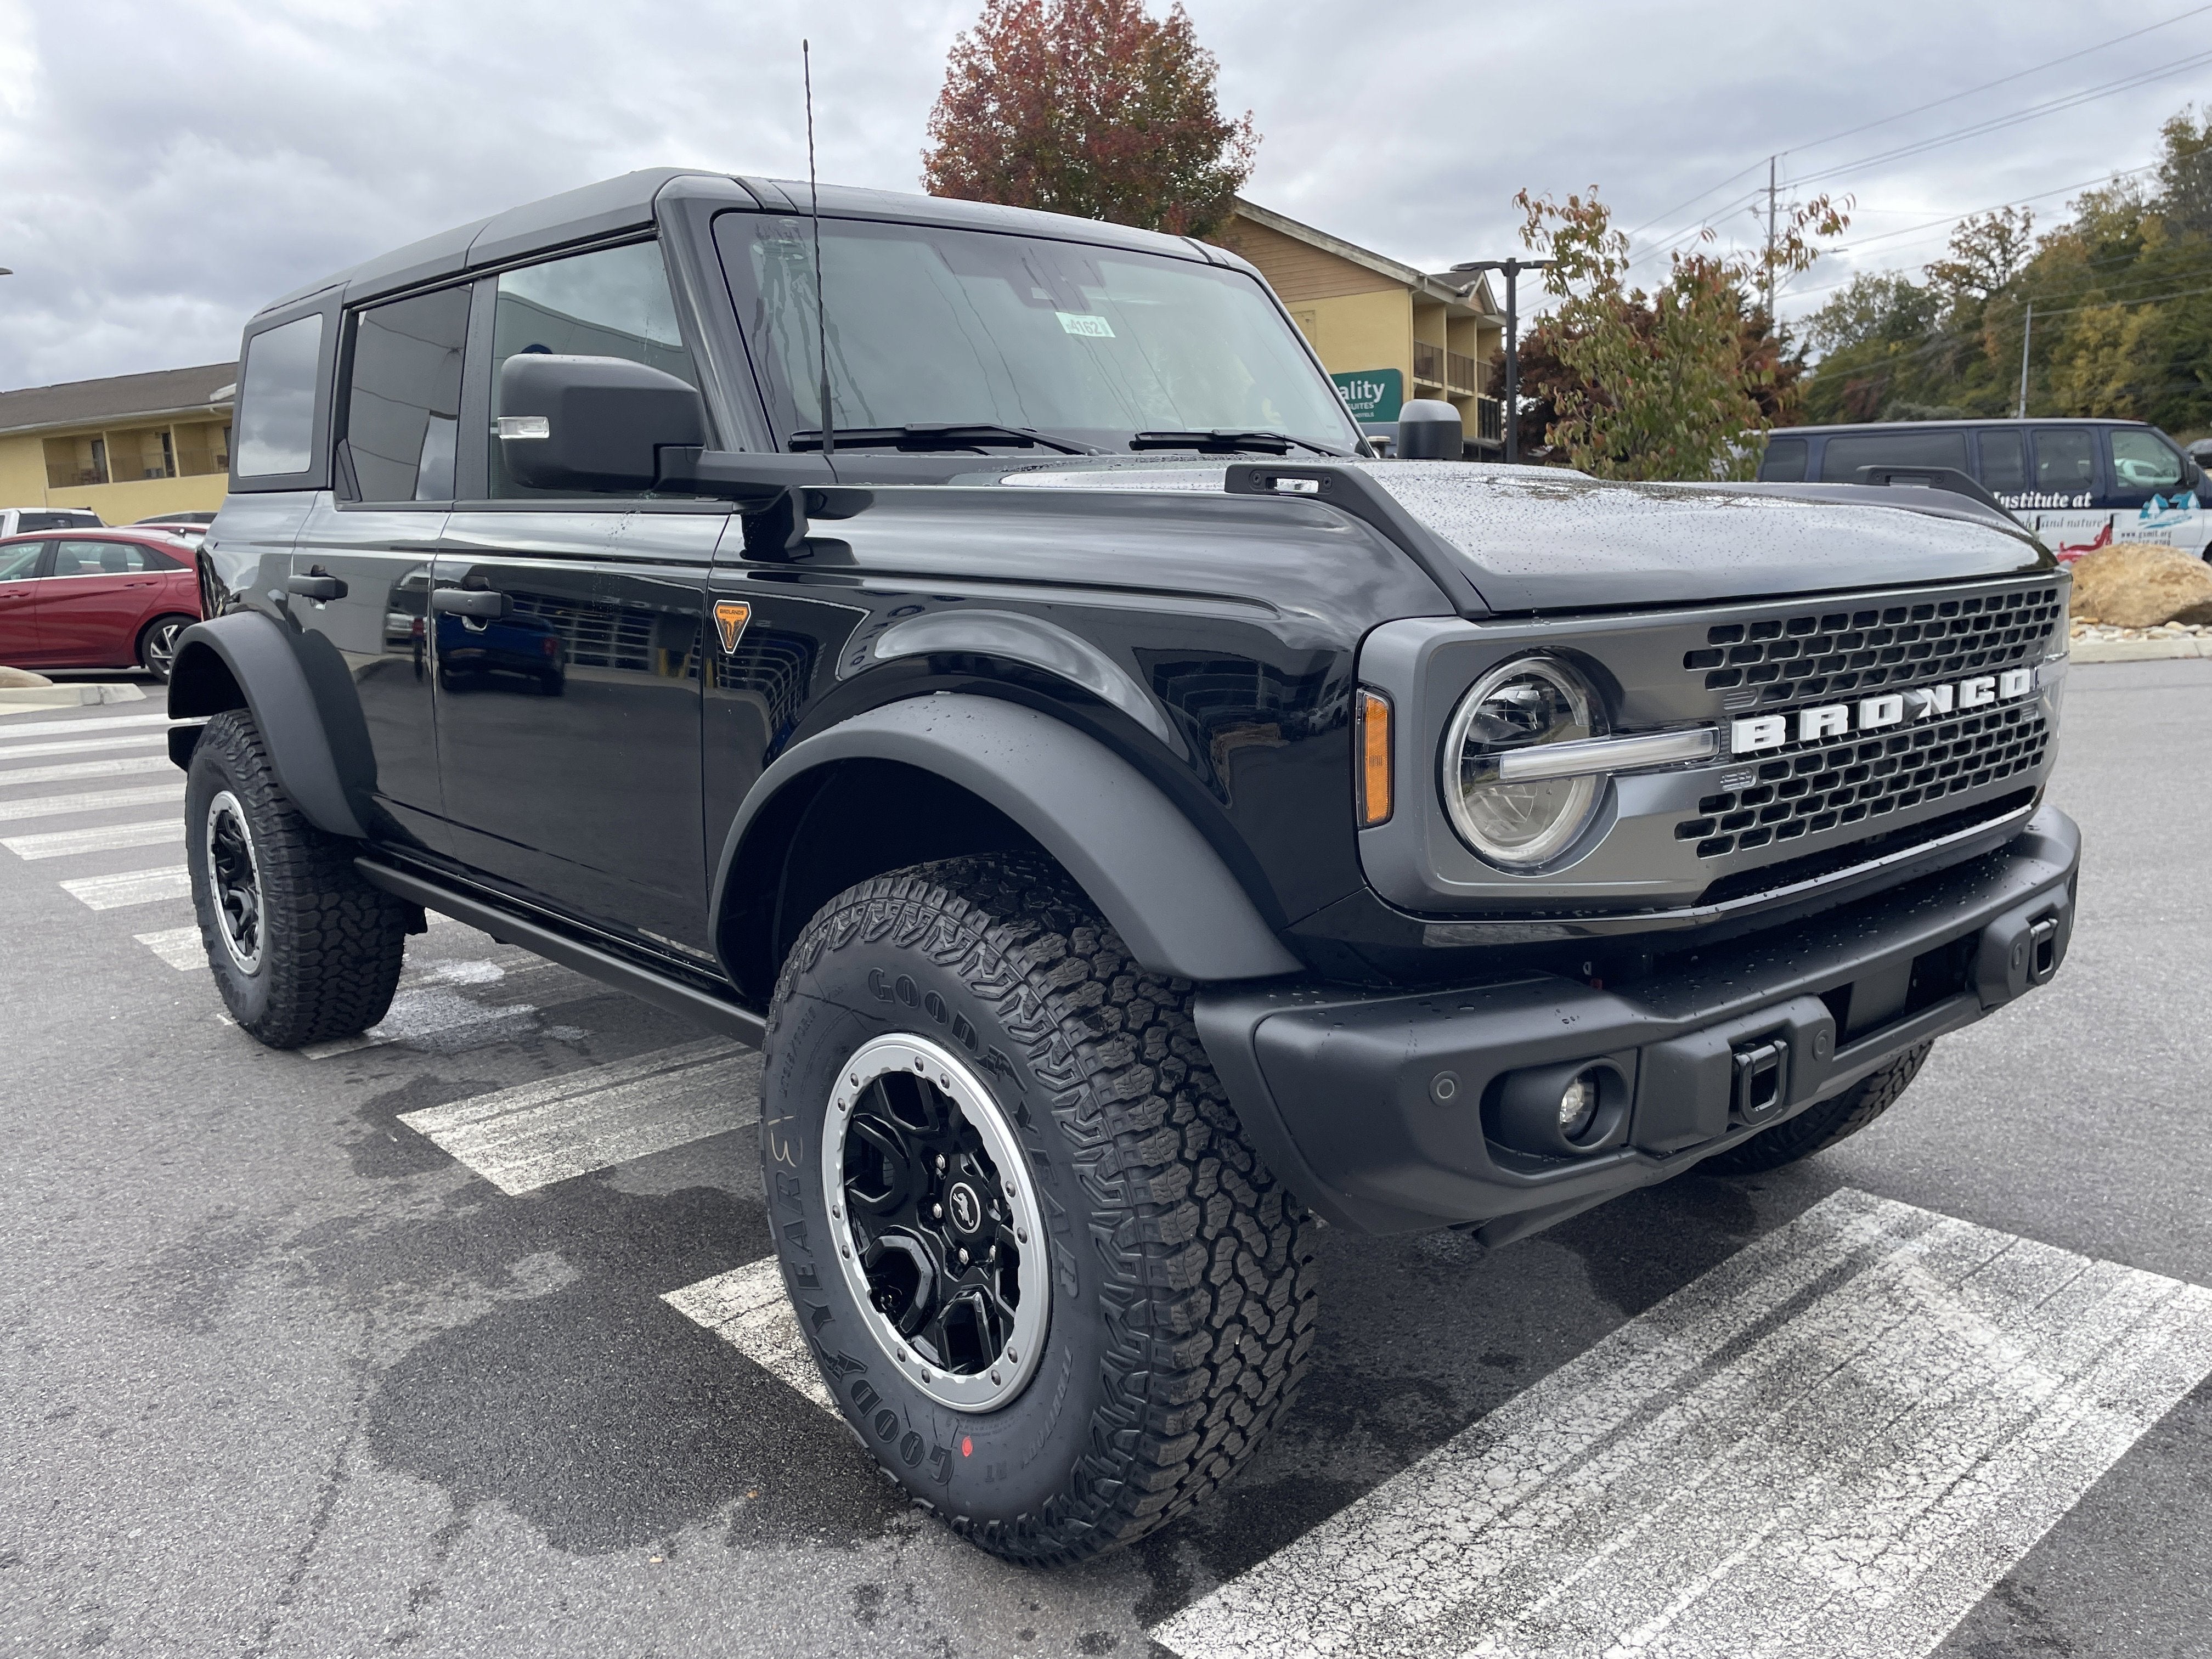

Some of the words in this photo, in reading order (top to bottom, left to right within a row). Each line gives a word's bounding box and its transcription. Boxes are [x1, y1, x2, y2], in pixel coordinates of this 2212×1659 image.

[1339, 380, 1385, 403] ality
[2072, 492, 2092, 508] at
[1730, 668, 2031, 754] BRONCO
